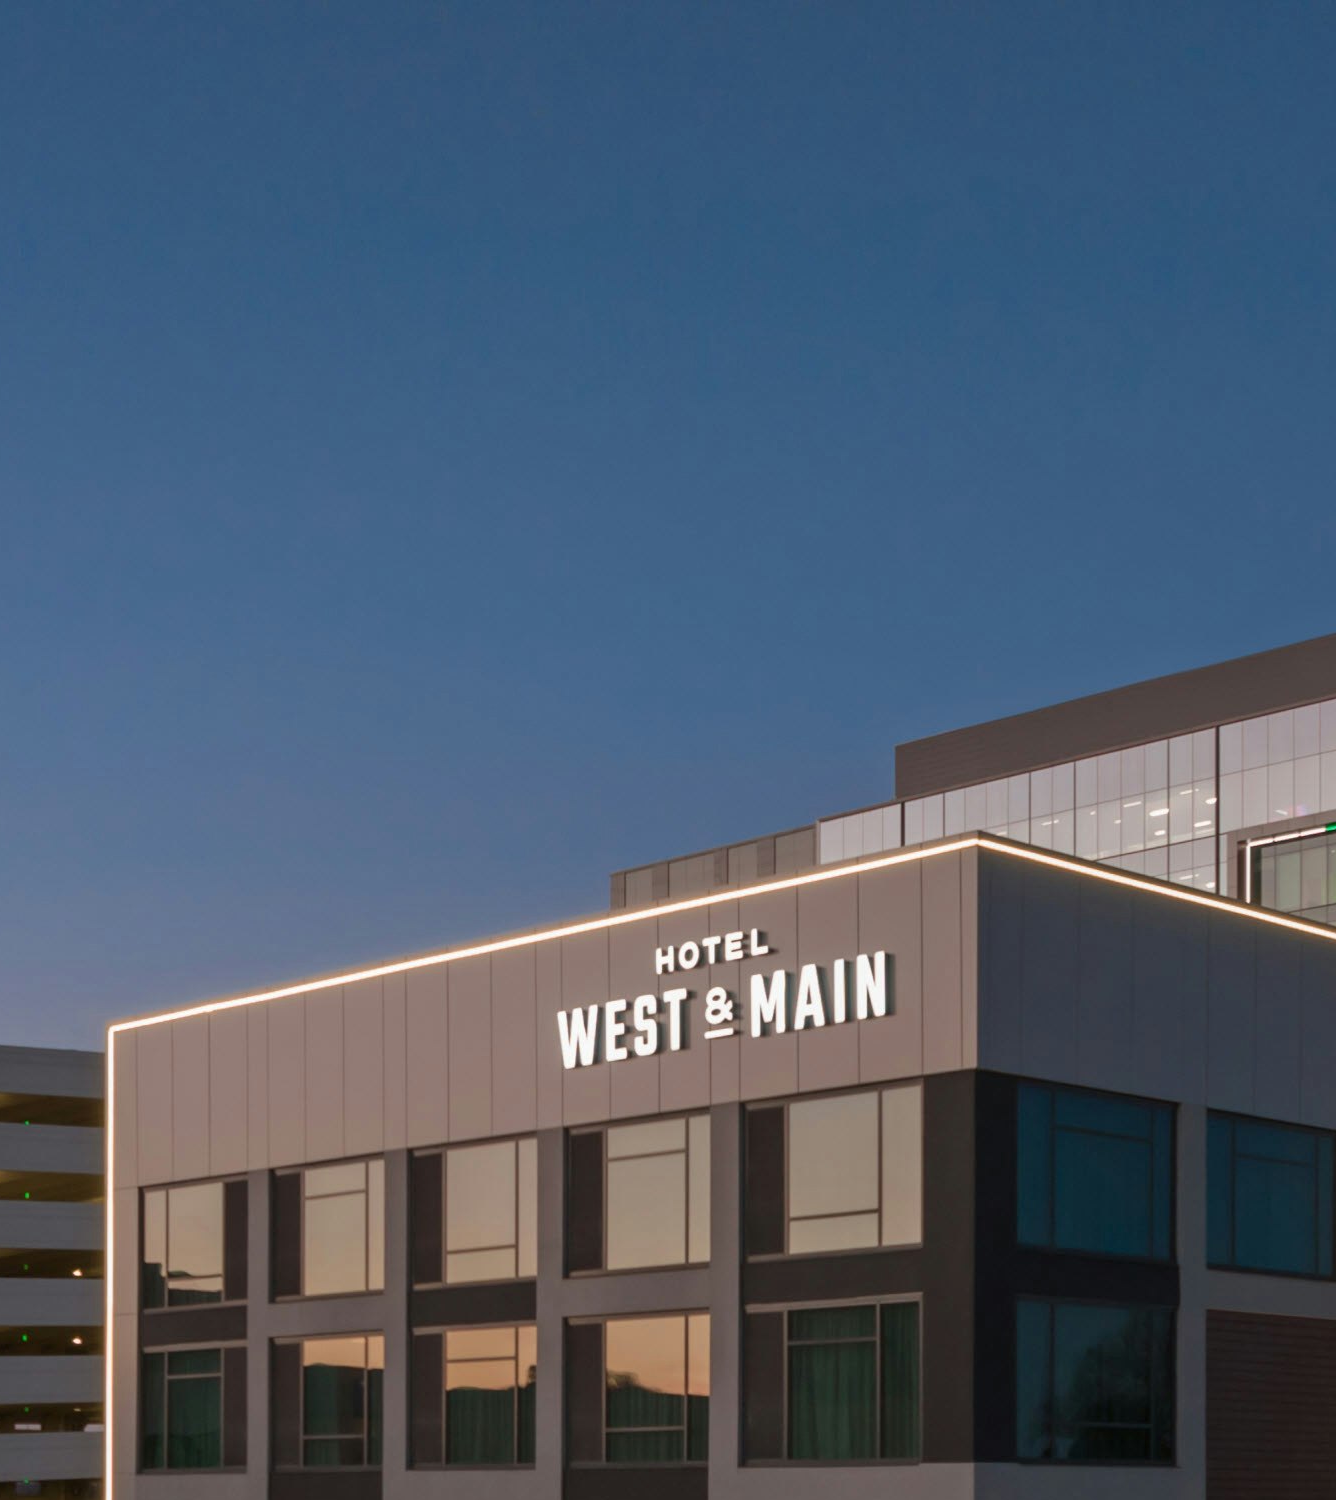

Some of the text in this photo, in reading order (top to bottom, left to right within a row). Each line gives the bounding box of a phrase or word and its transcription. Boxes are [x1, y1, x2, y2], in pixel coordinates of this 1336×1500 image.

[655, 928, 769, 975] HOTEL
[557, 950, 886, 1069] WEST & MAIN
